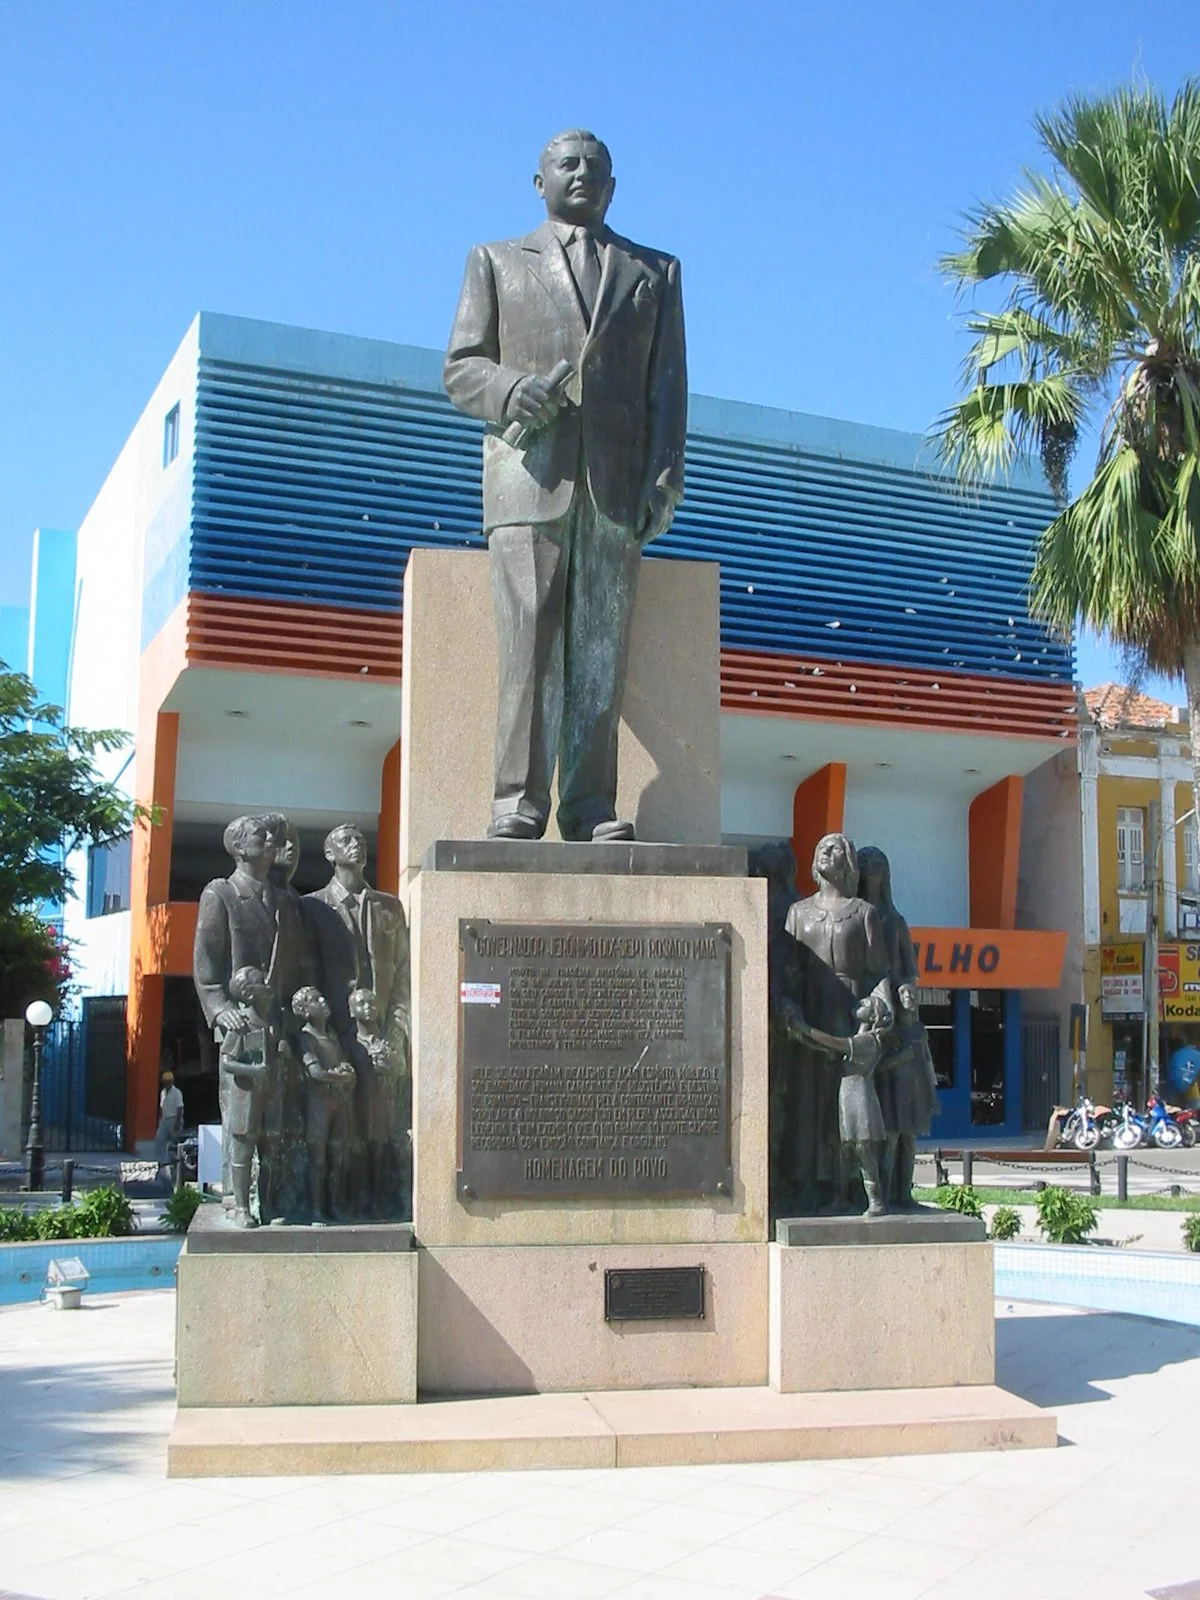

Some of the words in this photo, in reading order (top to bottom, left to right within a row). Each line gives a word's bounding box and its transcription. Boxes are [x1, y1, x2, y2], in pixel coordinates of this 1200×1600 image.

[524, 1157, 604, 1178] HOMENAGEM
[609, 1157, 627, 1178] DO
[633, 1157, 668, 1178] POVO
